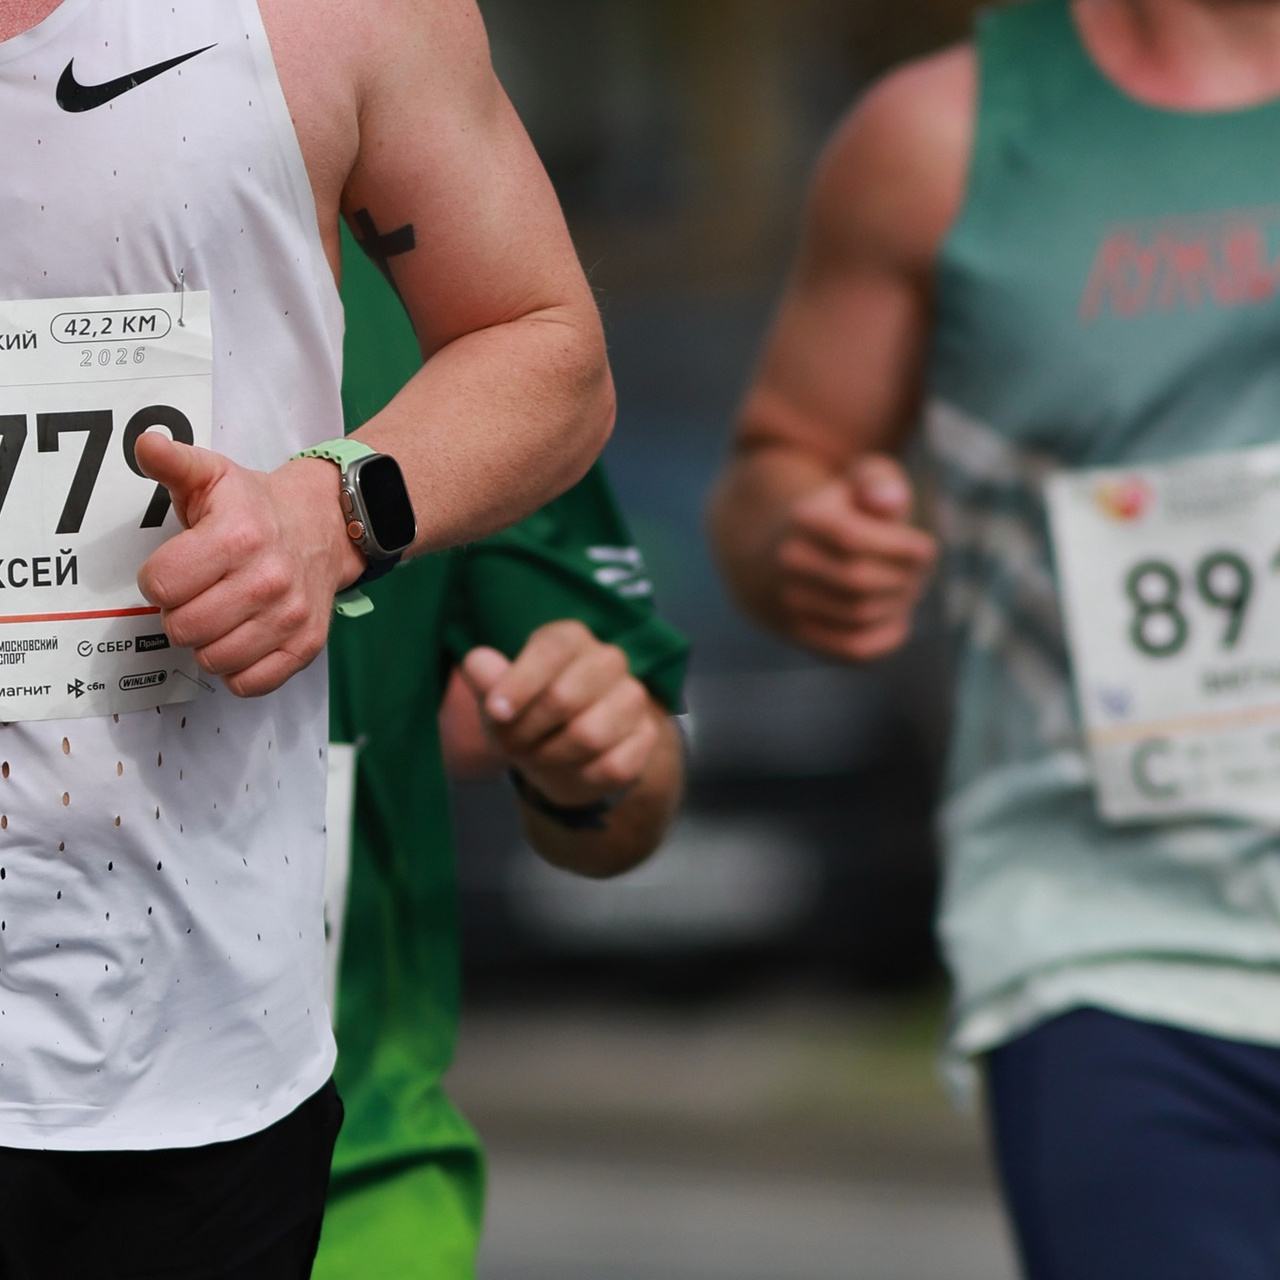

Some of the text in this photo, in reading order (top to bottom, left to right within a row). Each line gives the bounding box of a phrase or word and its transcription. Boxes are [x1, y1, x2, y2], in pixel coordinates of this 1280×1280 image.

[64, 317, 113, 338] 42,2
[80, 346, 146, 367] 2026
[1125, 549, 1280, 659] 89
[97, 640, 132, 653] СБЕР
[123, 675, 157, 687] WINLINE
